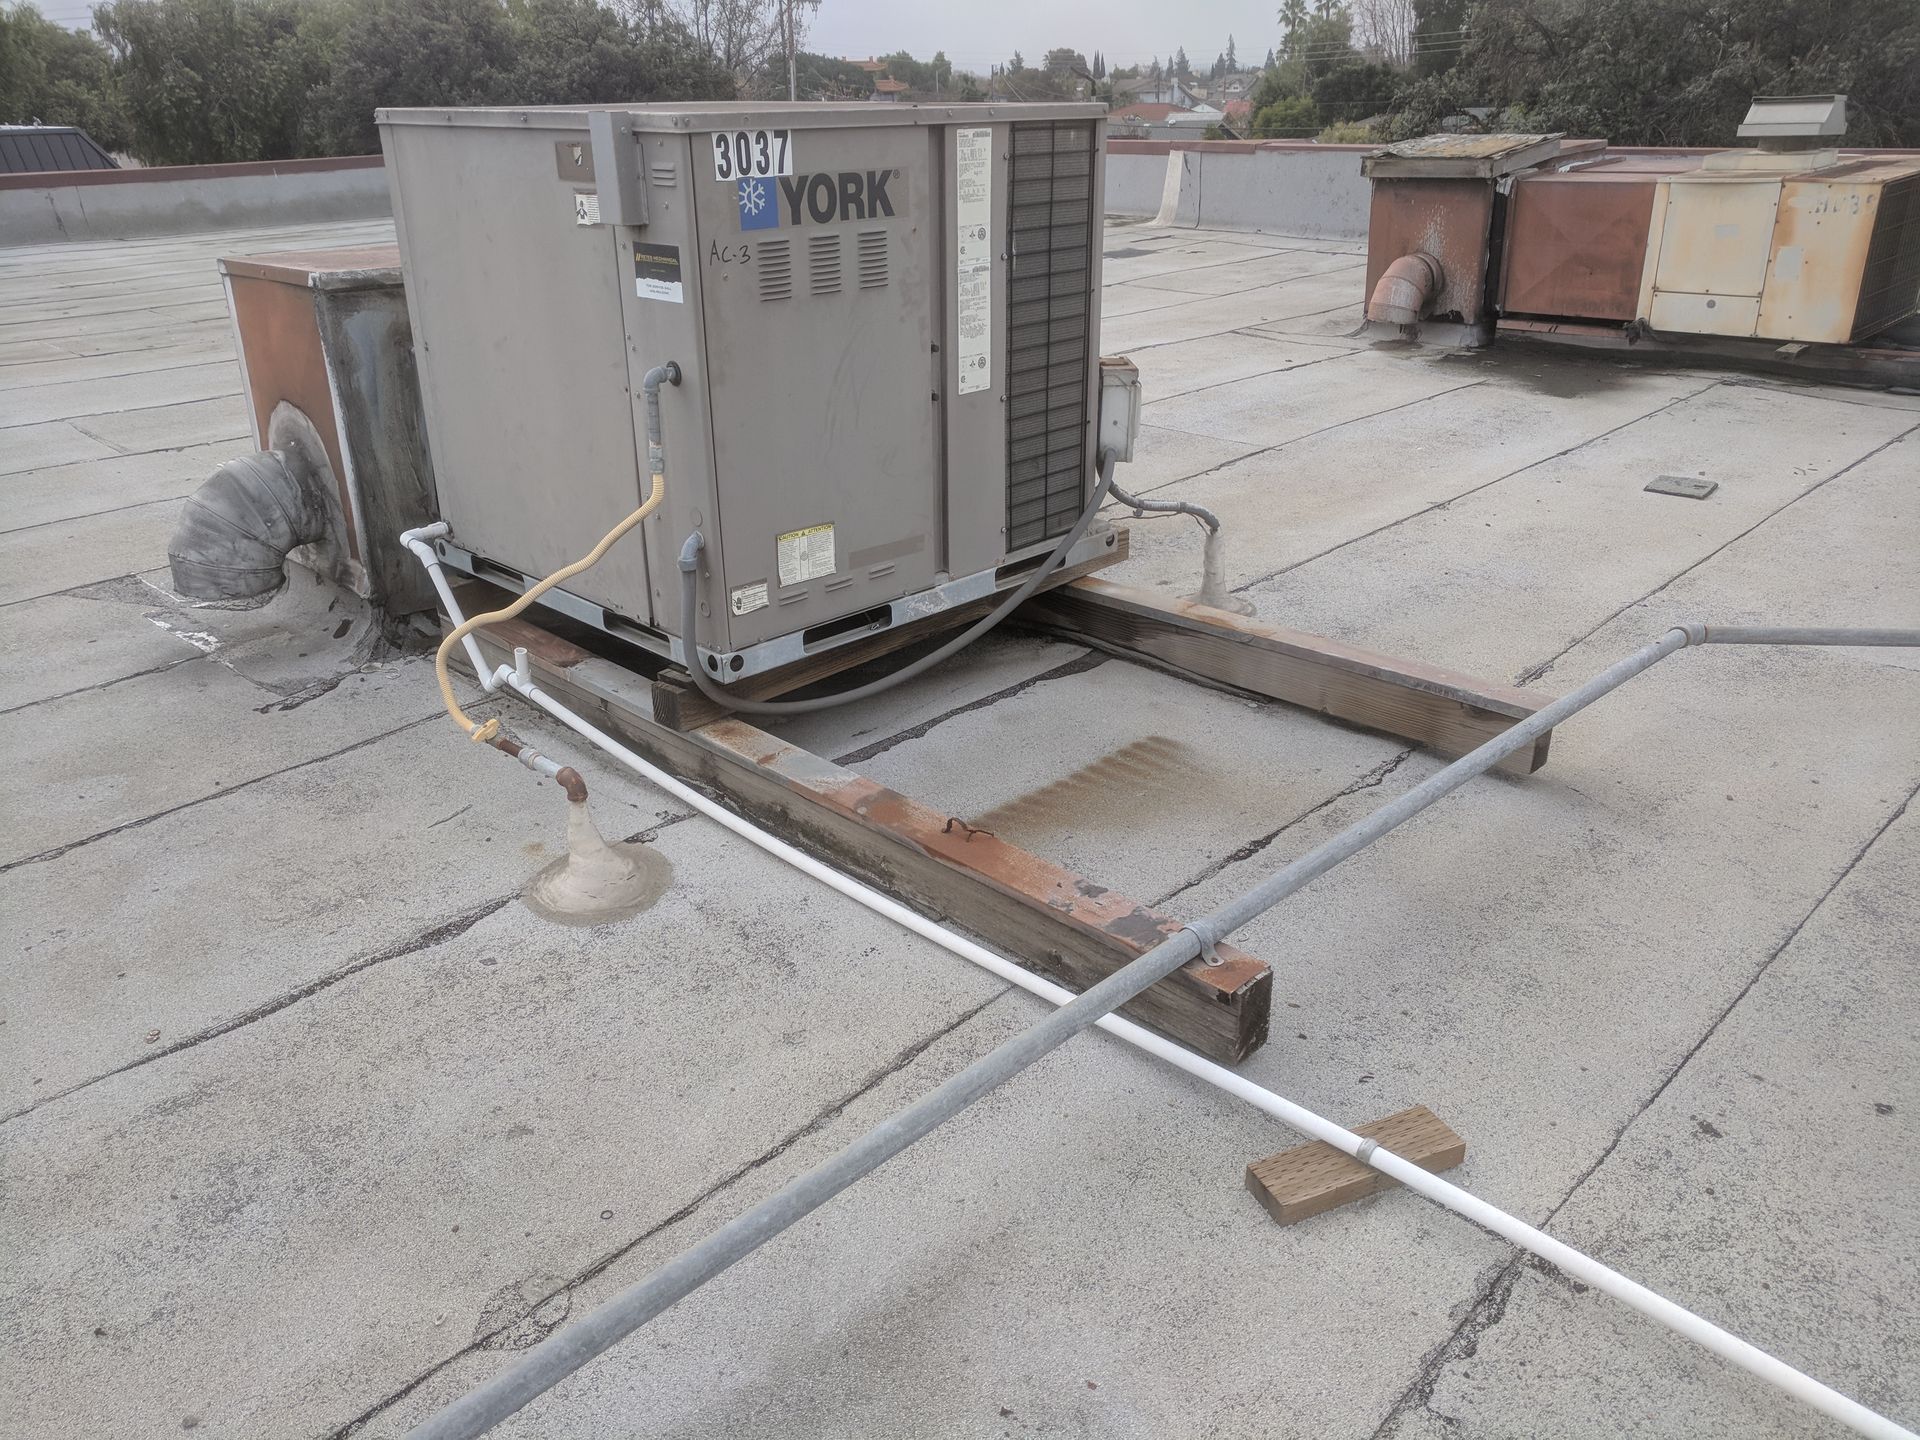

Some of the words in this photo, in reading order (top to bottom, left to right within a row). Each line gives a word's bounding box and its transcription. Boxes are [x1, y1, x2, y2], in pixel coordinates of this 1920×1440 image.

[715, 130, 788, 178] 3037
[778, 169, 896, 225] YORK
[779, 532, 799, 540] CAUTION
[808, 525, 832, 534] ATTENTION
